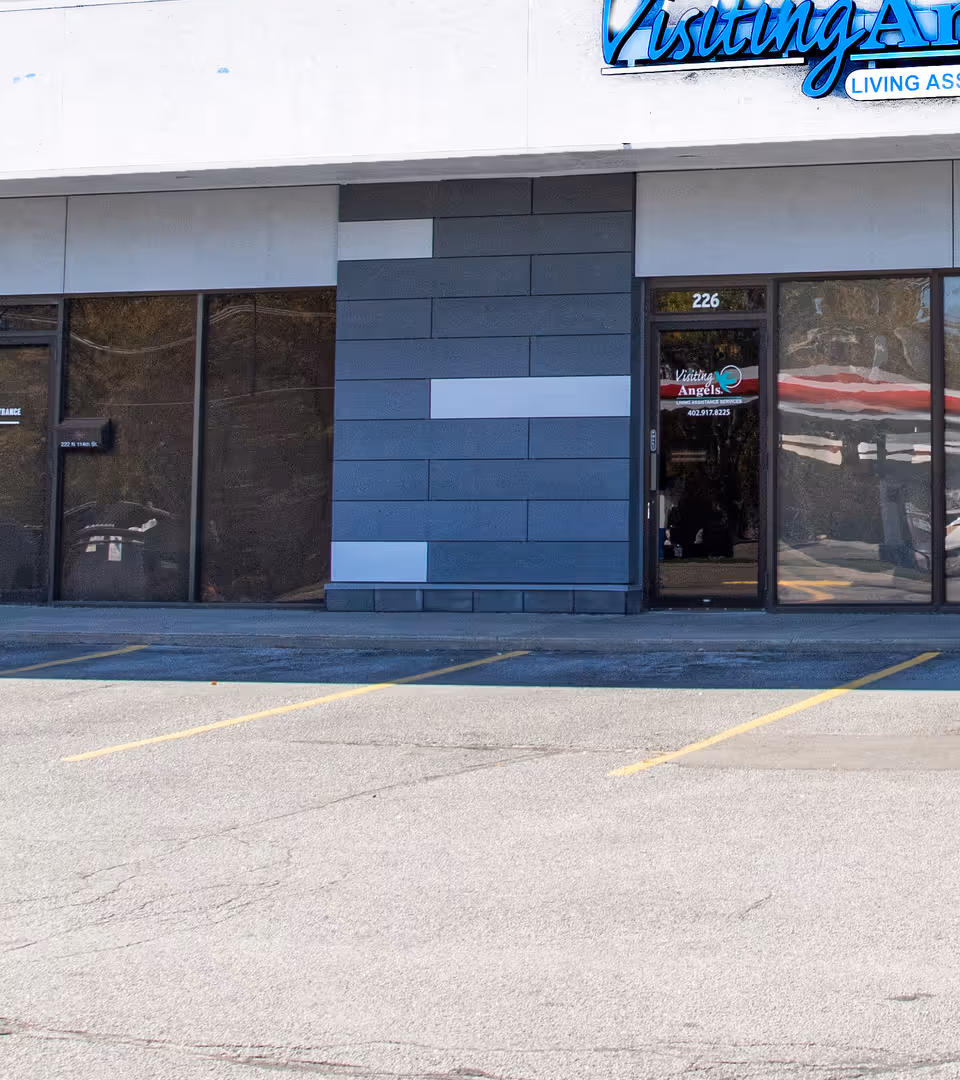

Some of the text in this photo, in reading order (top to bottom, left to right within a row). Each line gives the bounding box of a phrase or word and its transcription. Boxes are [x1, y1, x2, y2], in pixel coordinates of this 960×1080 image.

[852, 74, 920, 94] LIVING
[692, 292, 720, 308] 226
[676, 369, 713, 388] Visiting
[687, 408, 731, 417] 402.917.8225
